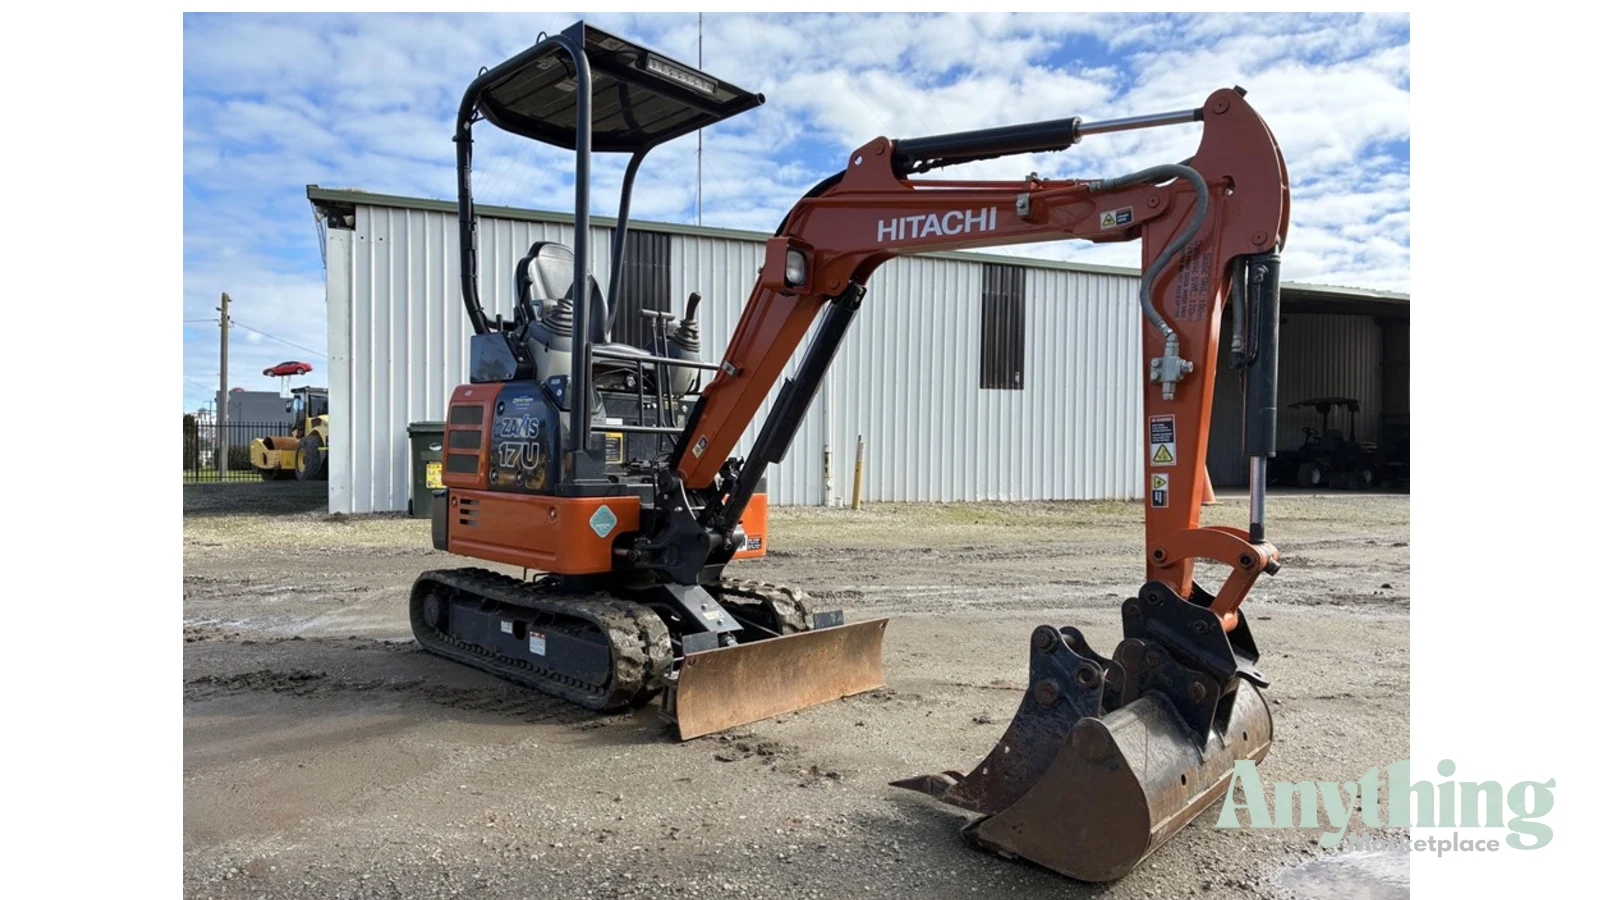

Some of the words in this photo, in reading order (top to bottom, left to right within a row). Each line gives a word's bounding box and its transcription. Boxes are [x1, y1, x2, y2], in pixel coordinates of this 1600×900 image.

[877, 206, 997, 242] HITACHI
[501, 414, 539, 439] ZAXIS
[499, 442, 539, 470] 17U
